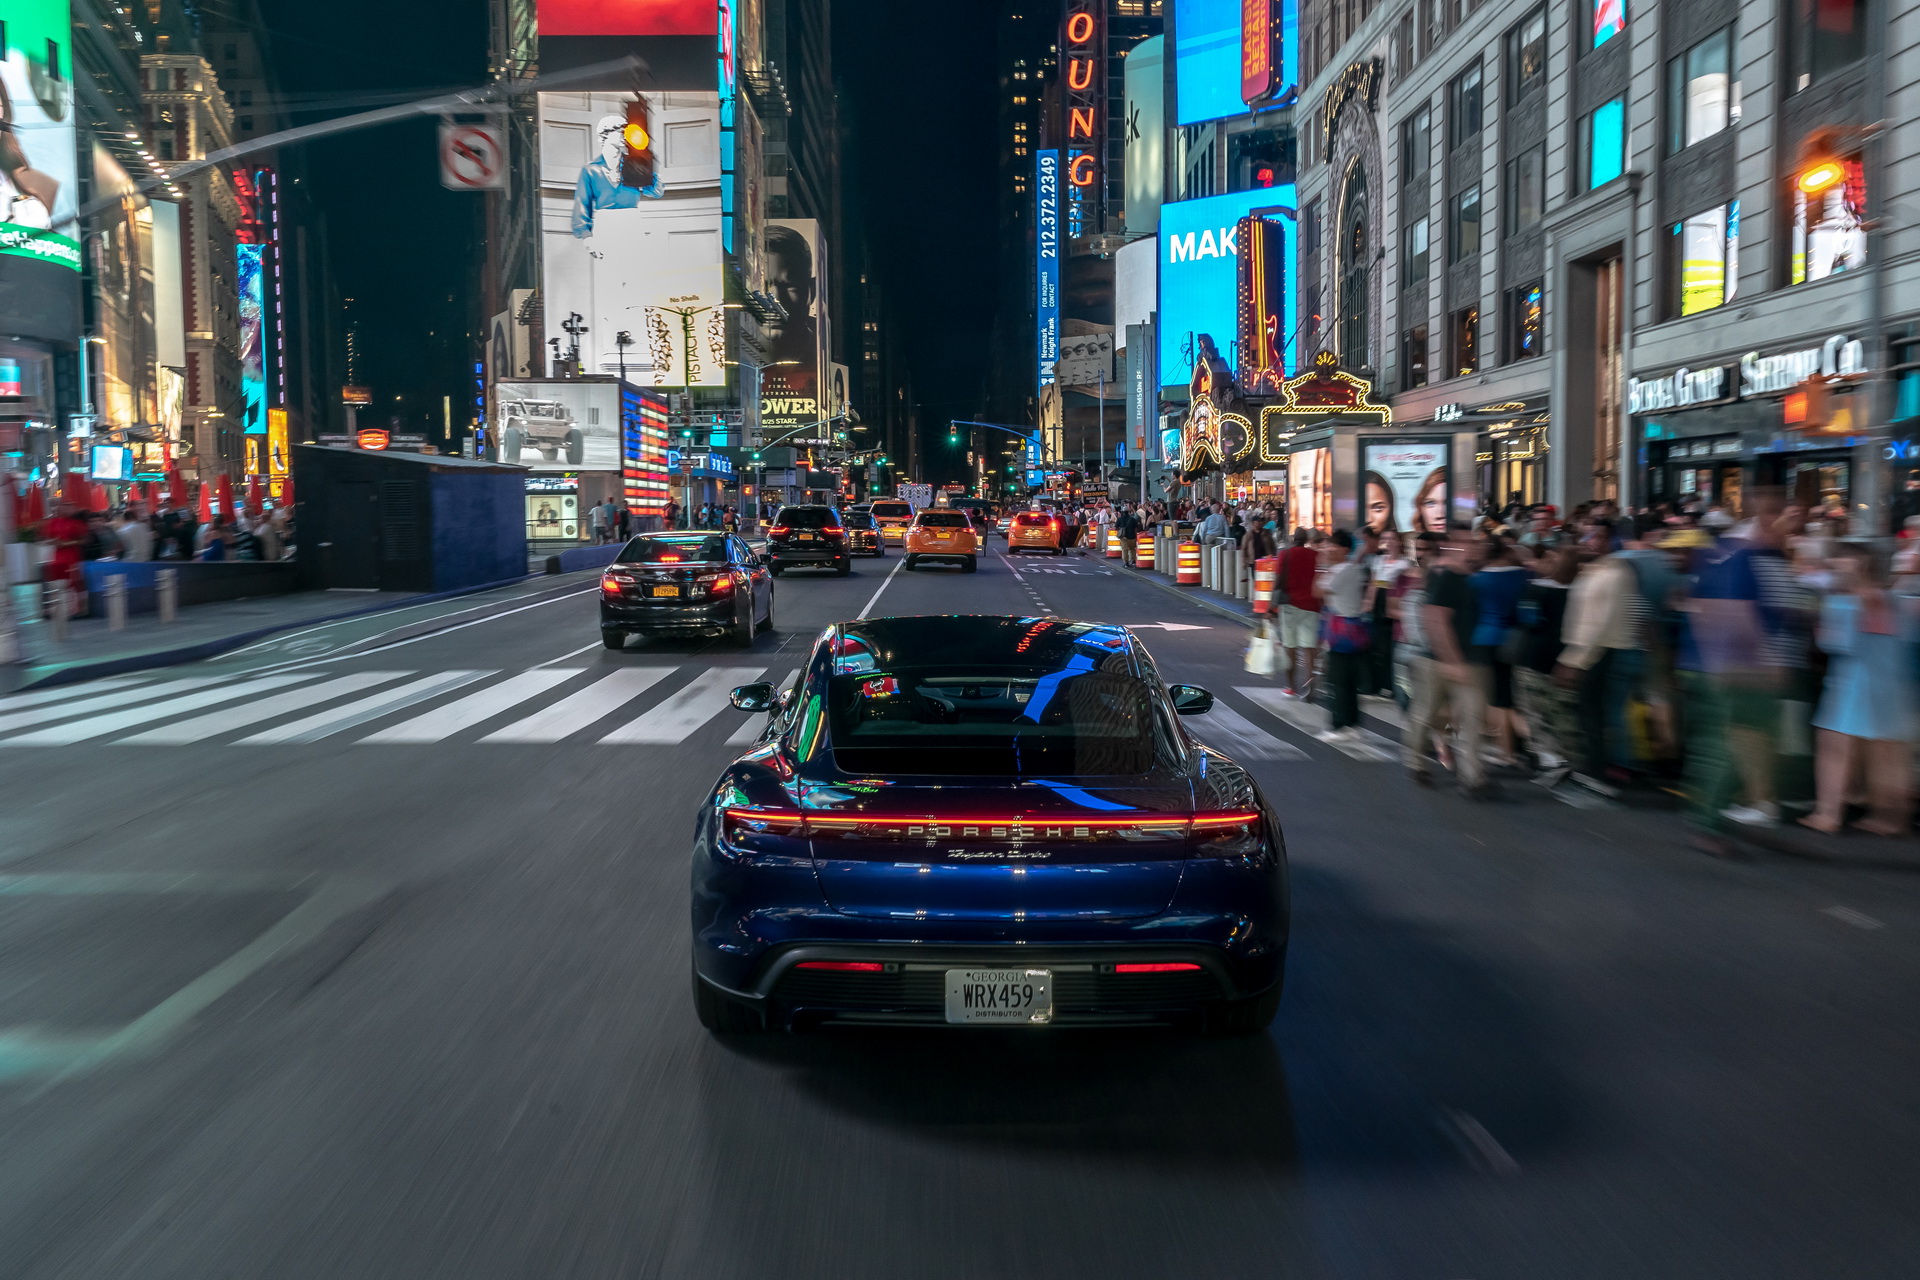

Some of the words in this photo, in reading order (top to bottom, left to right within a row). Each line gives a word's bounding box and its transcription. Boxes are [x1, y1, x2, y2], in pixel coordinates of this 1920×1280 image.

[1068, 12, 1095, 186] OUNG
[1041, 156, 1056, 258] 212.372.2349
[681, 294, 700, 302] Shells
[1048, 336, 1056, 358] Knight
[1018, 567, 1113, 576] ONLY
[908, 825, 1089, 837] PORSCHE
[971, 971, 1028, 982] GEORGIA
[963, 983, 1034, 1009] WRX459
[975, 1010, 1023, 1018] DISTRIBUTOR
